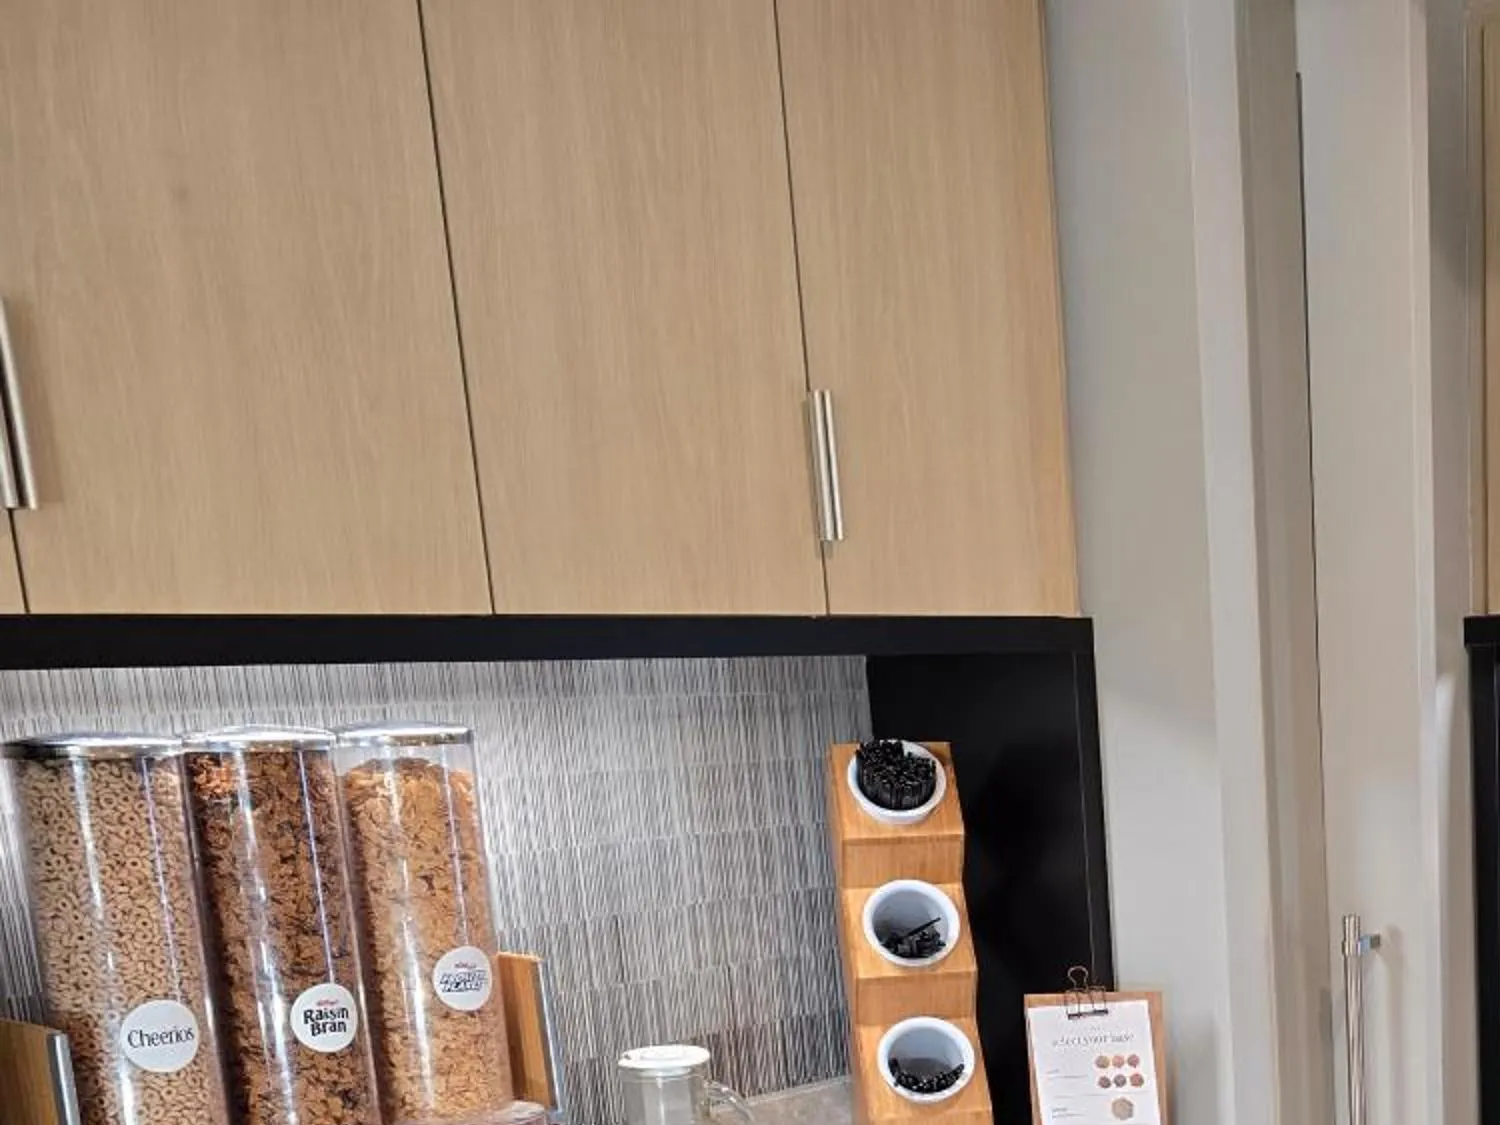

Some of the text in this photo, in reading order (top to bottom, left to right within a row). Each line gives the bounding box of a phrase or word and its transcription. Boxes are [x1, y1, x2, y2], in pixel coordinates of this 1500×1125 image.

[303, 1007, 349, 1024] Raisin
[127, 1026, 195, 1048] Cheerios
[310, 1021, 347, 1036] Bran
